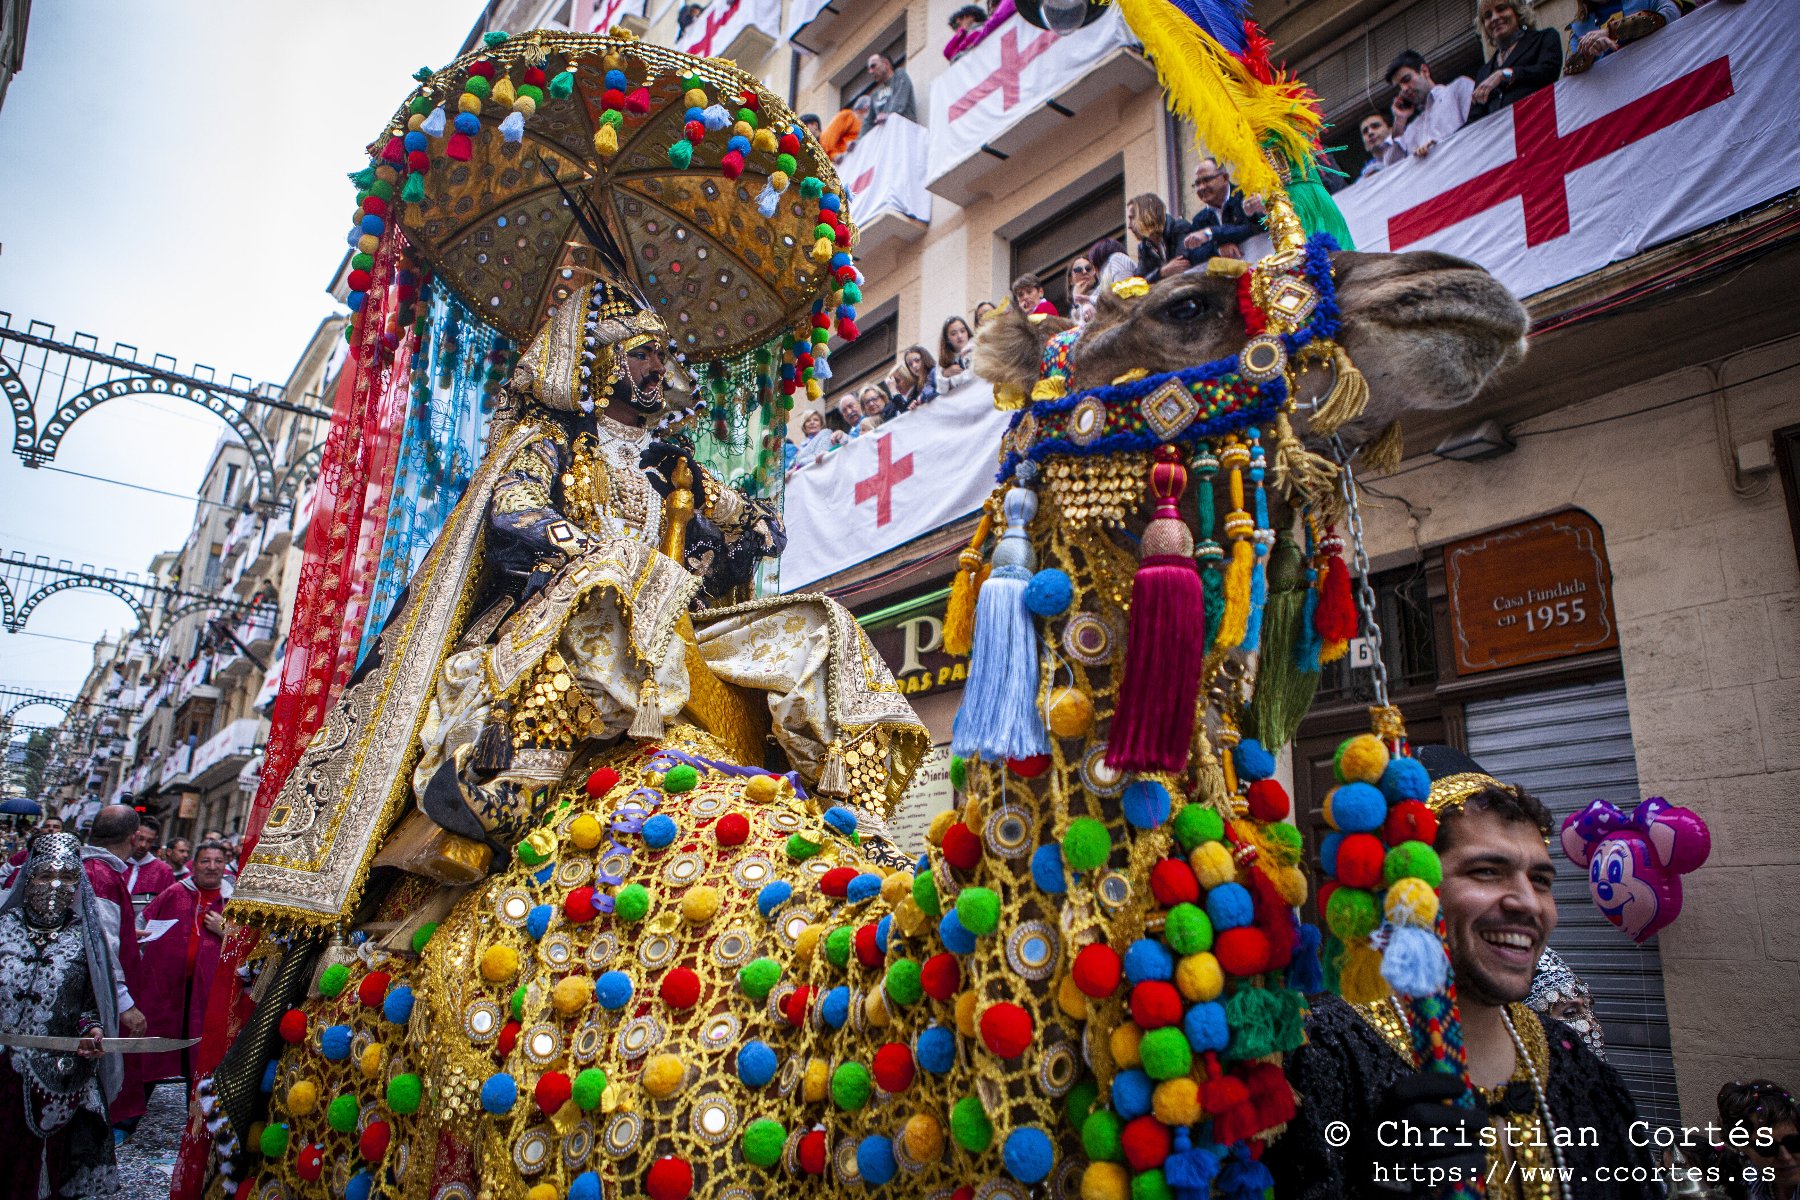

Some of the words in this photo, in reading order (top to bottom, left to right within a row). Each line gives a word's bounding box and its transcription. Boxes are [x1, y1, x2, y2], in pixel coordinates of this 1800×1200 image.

[1493, 596, 1524, 612] Casa
[1527, 577, 1587, 604] Fundada
[1498, 614, 1516, 627] en
[1525, 598, 1586, 633] 1955
[1359, 643, 1368, 660] 6
[937, 660, 972, 685] PA
